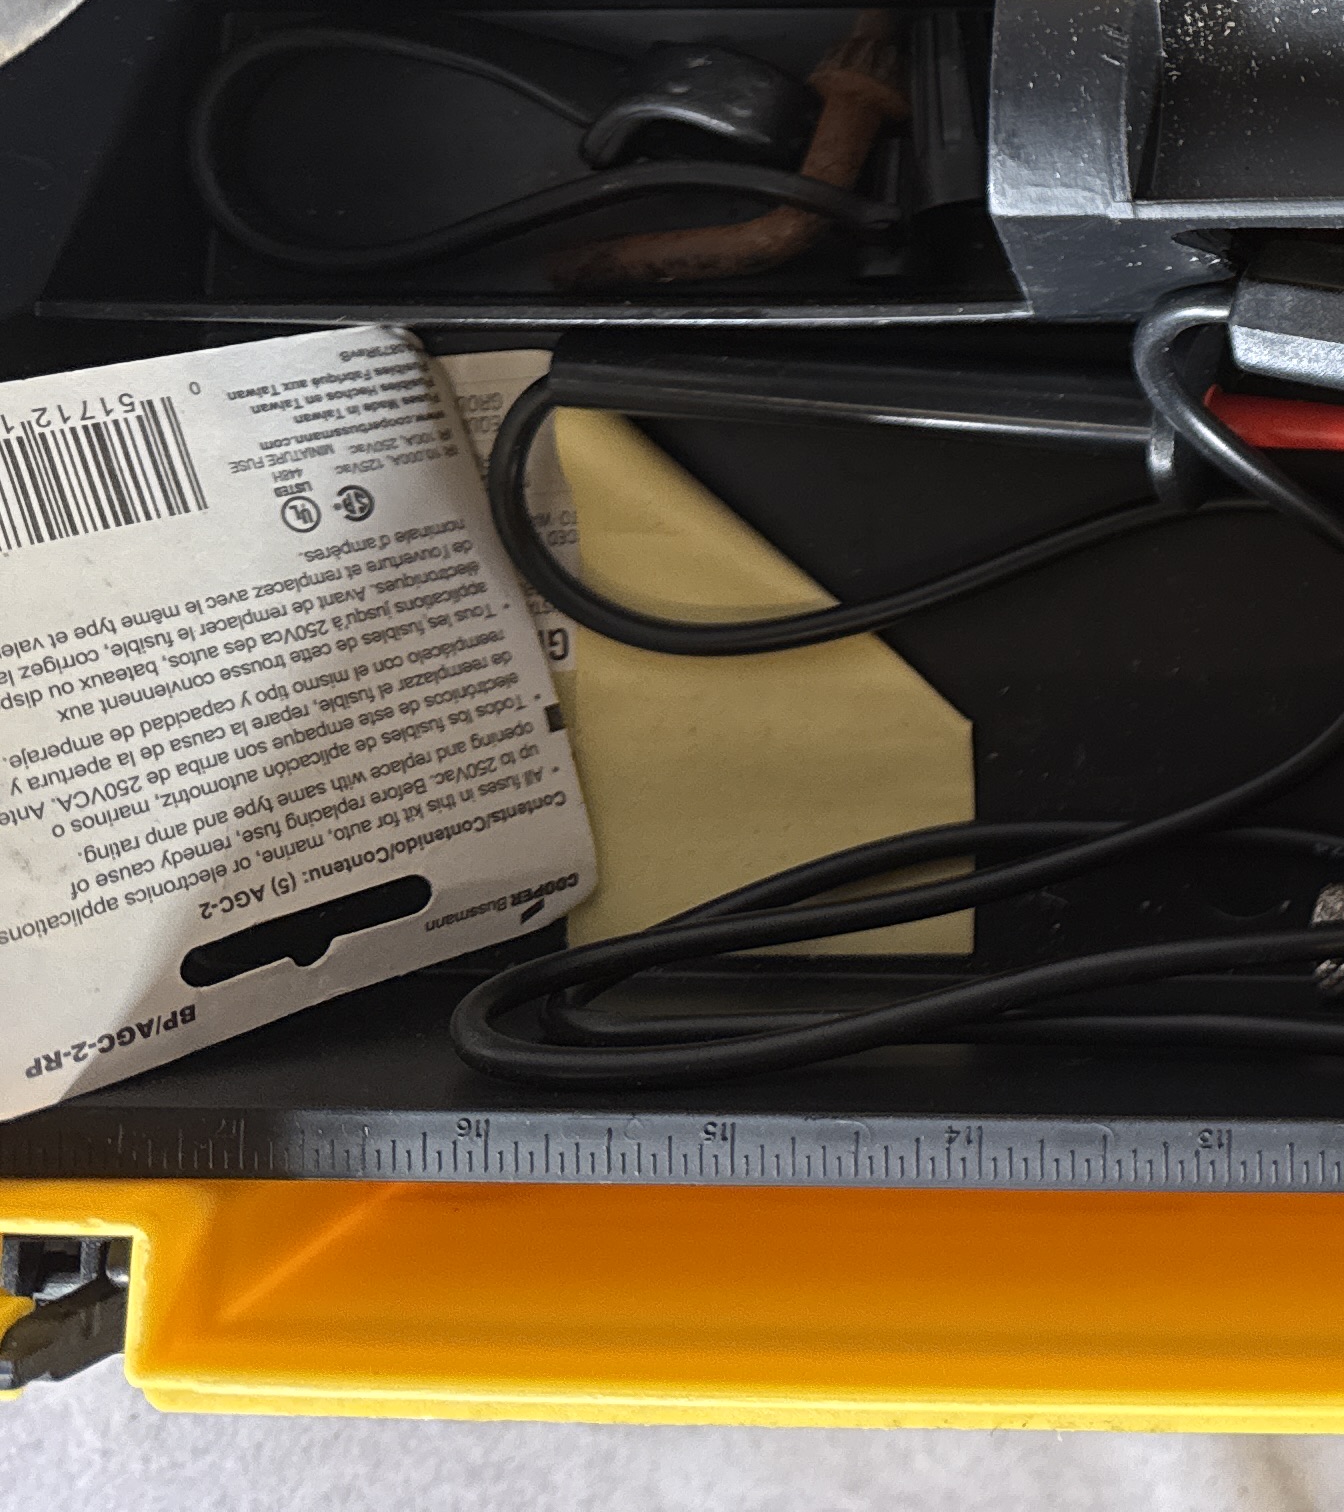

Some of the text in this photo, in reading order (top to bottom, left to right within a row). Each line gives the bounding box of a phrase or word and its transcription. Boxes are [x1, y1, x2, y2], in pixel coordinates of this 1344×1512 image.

[17, 584, 366, 679] Avant remplacer fusible, corrigez
[72, 567, 343, 639] remplacez avec même type
[55, 619, 425, 722] fusibles trousse conviennent aux
[78, 635, 257, 690] des autos, bateaux
[2, 668, 350, 768] mismo capacidad amperaje.
[25, 703, 309, 790] repare causa apertura
[50, 716, 354, 812] empaque 250VCA.
[69, 716, 445, 832] fusibles aplicación automotriz, marinos
[76, 739, 466, 863] and replace with same type and amp rating.
[69, 777, 426, 900] Before replacing remedy cause of
[123, 792, 456, 905] this marine, electronics
[198, 790, 565, 919] Contents/Contenido/Contenu: (5) AGC-2
[423, 872, 578, 931] COOPER Bussmann
[24, 1004, 198, 1082] BP/AGC-2-RP
[453, 1120, 728, 1144] 15 16
